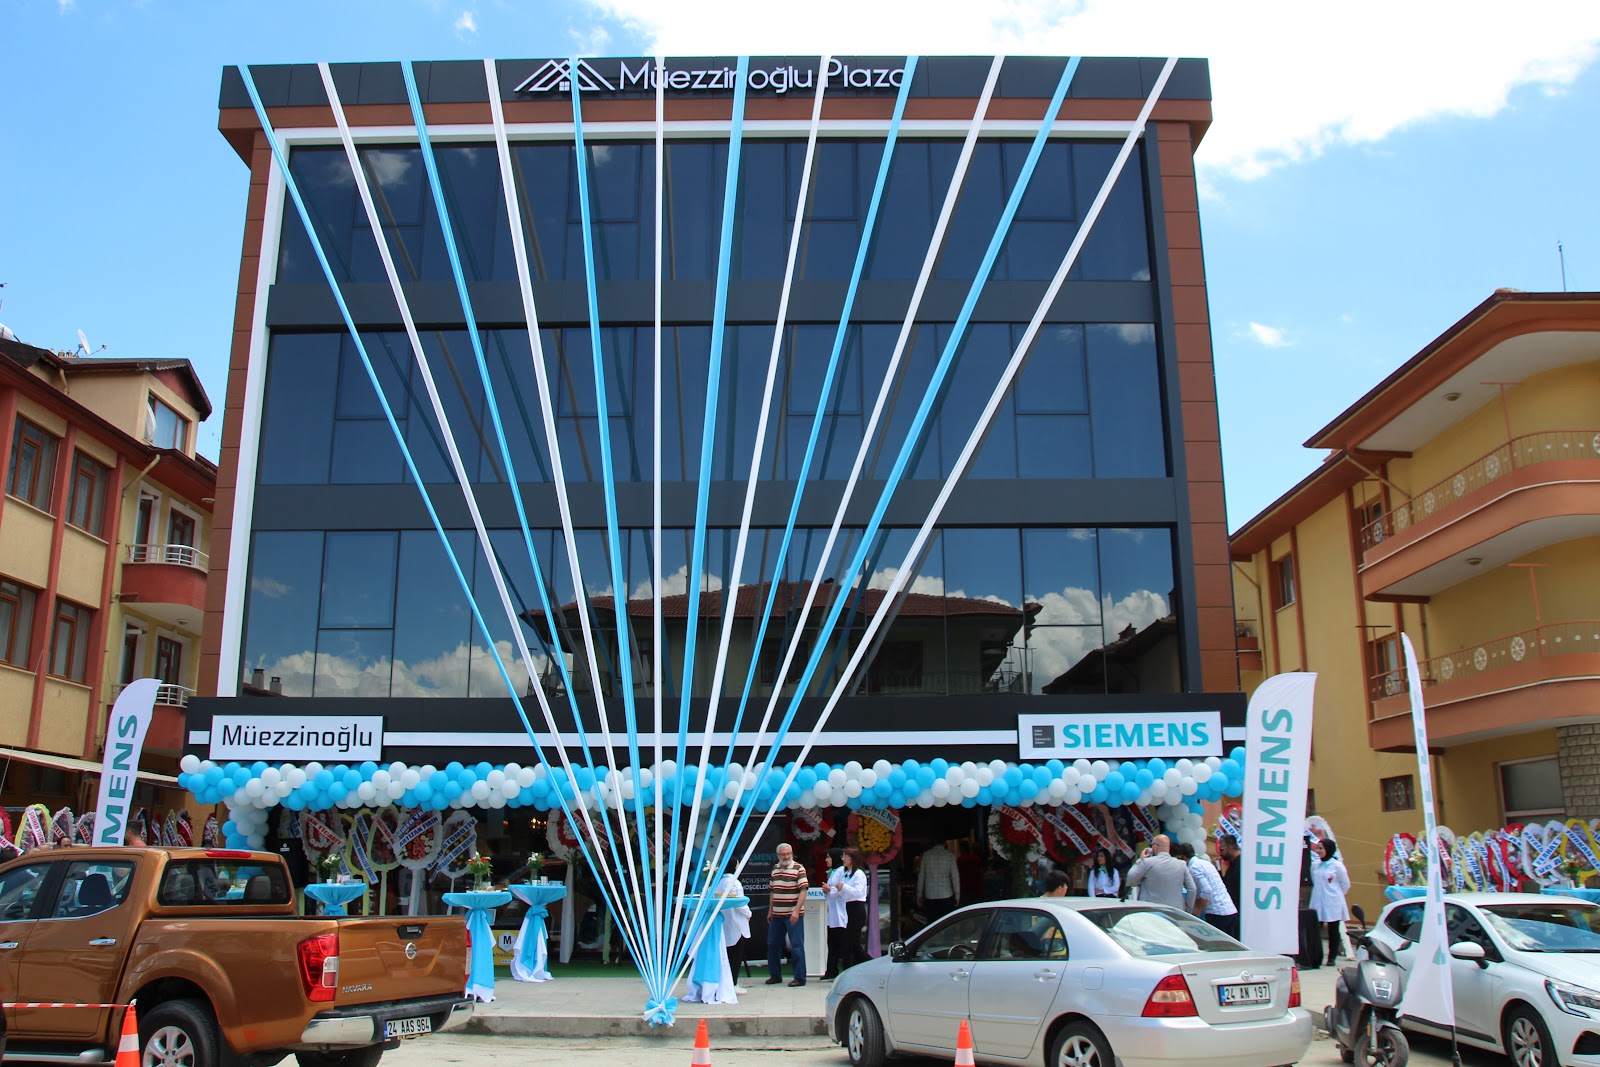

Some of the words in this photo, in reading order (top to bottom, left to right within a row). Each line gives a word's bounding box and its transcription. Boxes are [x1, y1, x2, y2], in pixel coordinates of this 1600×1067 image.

[222, 724, 372, 752] Müezzinoğlu
[1062, 722, 1209, 749] SIEMENS
[101, 714, 138, 844] MENS
[1254, 708, 1293, 910] SIEMENS
[1047, 814, 1071, 833] AYHAN
[1070, 832, 1089, 854] TAMER
[342, 984, 373, 994] NAVARA
[1225, 988, 1235, 1000] 24
[1240, 987, 1250, 999] AN
[1254, 986, 1267, 998] 197
[388, 1022, 397, 1036] 24
[401, 1019, 415, 1034] AAS
[416, 1018, 430, 1032] 964
